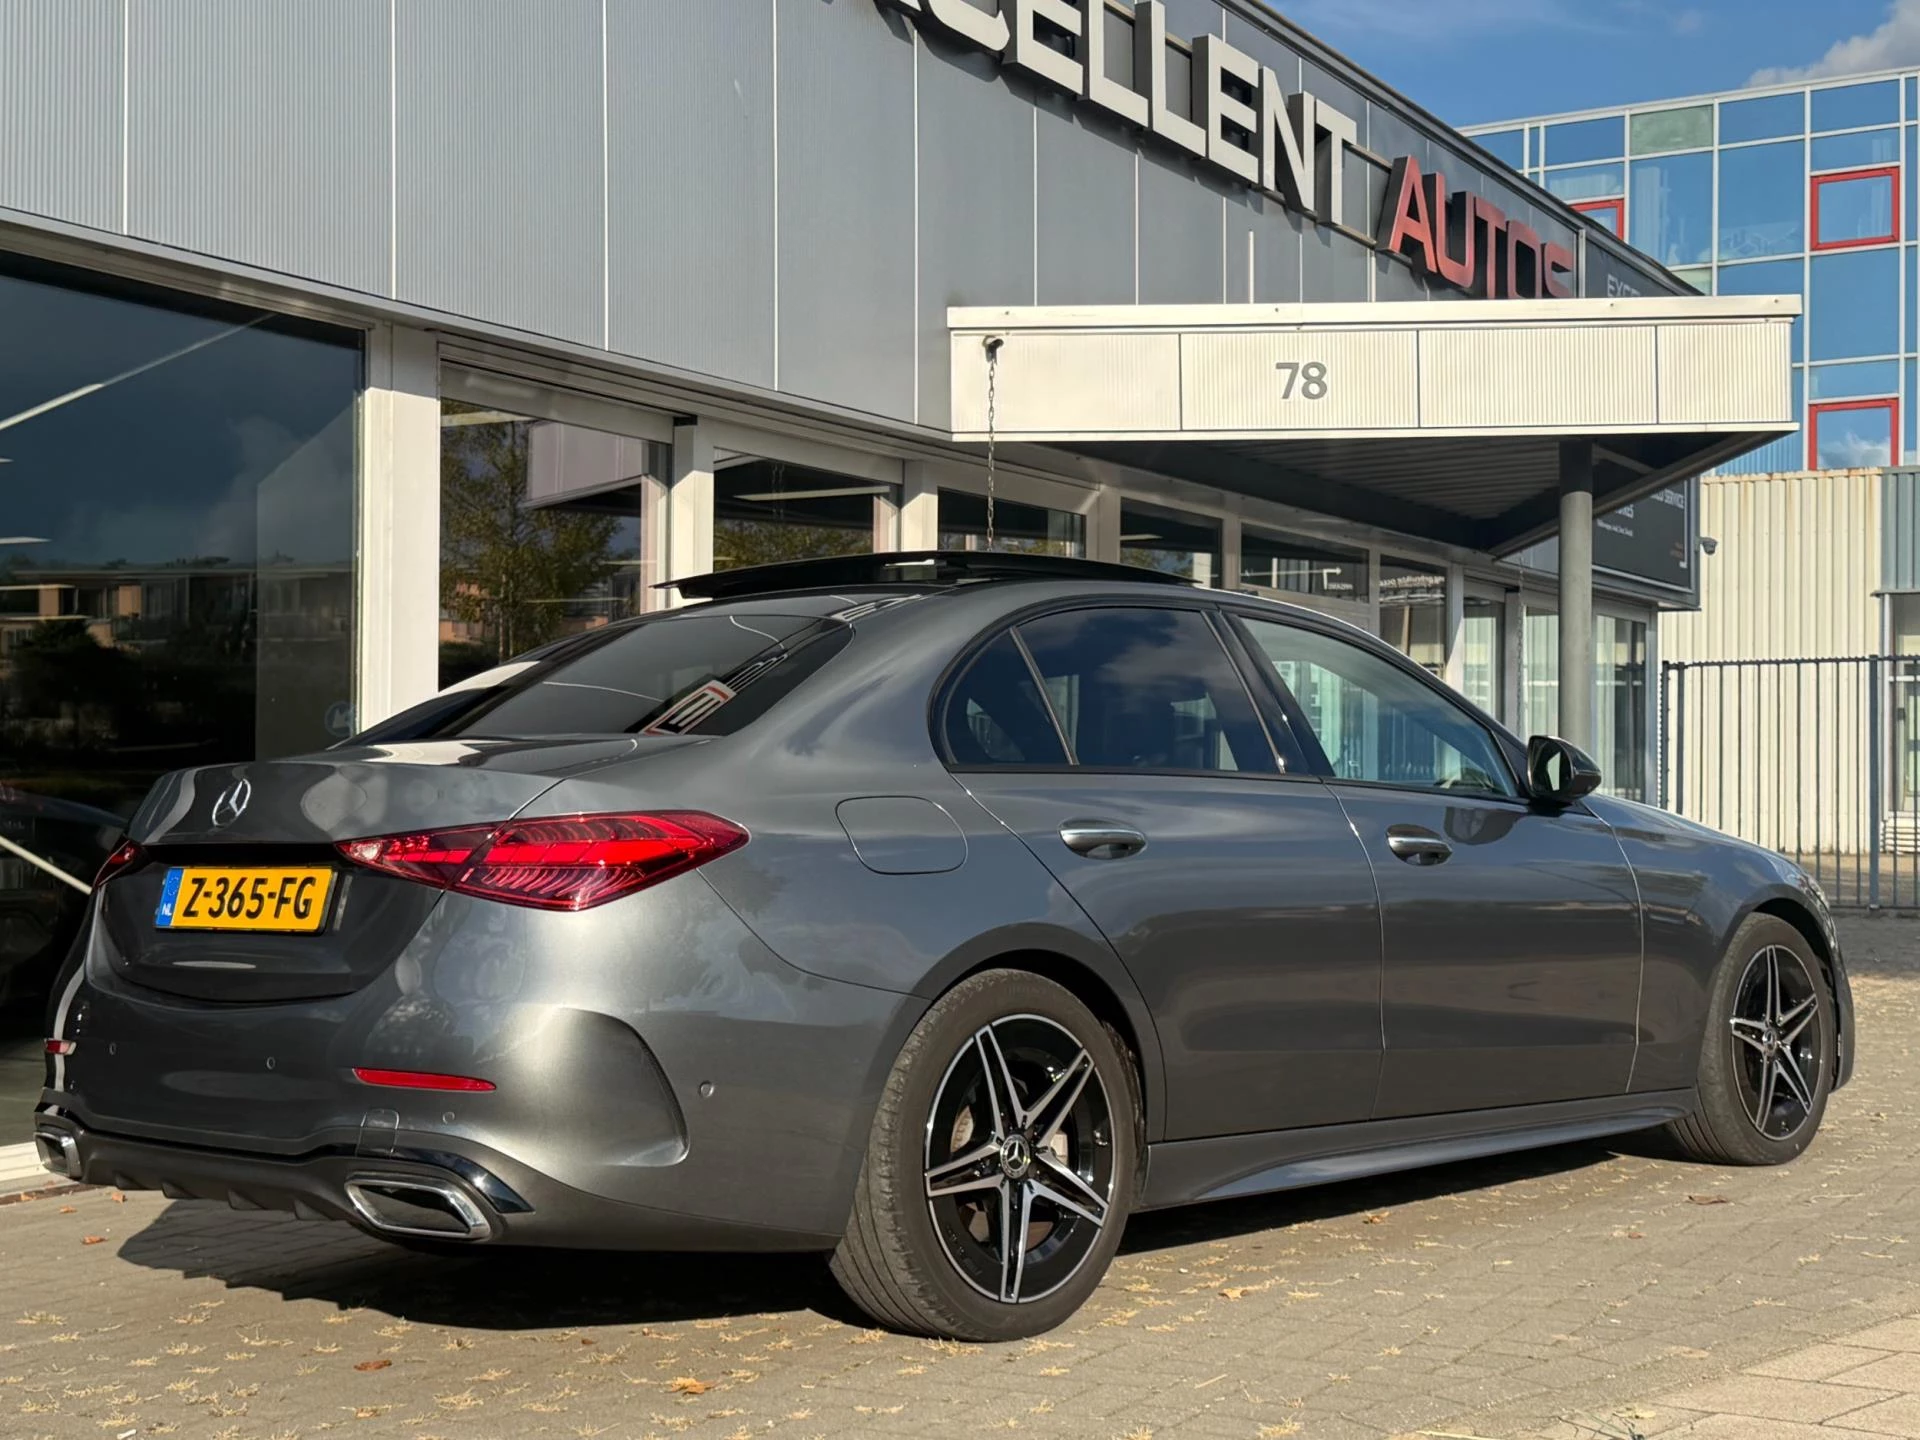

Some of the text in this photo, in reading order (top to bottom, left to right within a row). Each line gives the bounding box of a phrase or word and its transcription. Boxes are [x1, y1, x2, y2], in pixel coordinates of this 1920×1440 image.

[1275, 361, 1328, 400] 78
[161, 876, 317, 920] NL Z-365-FG
